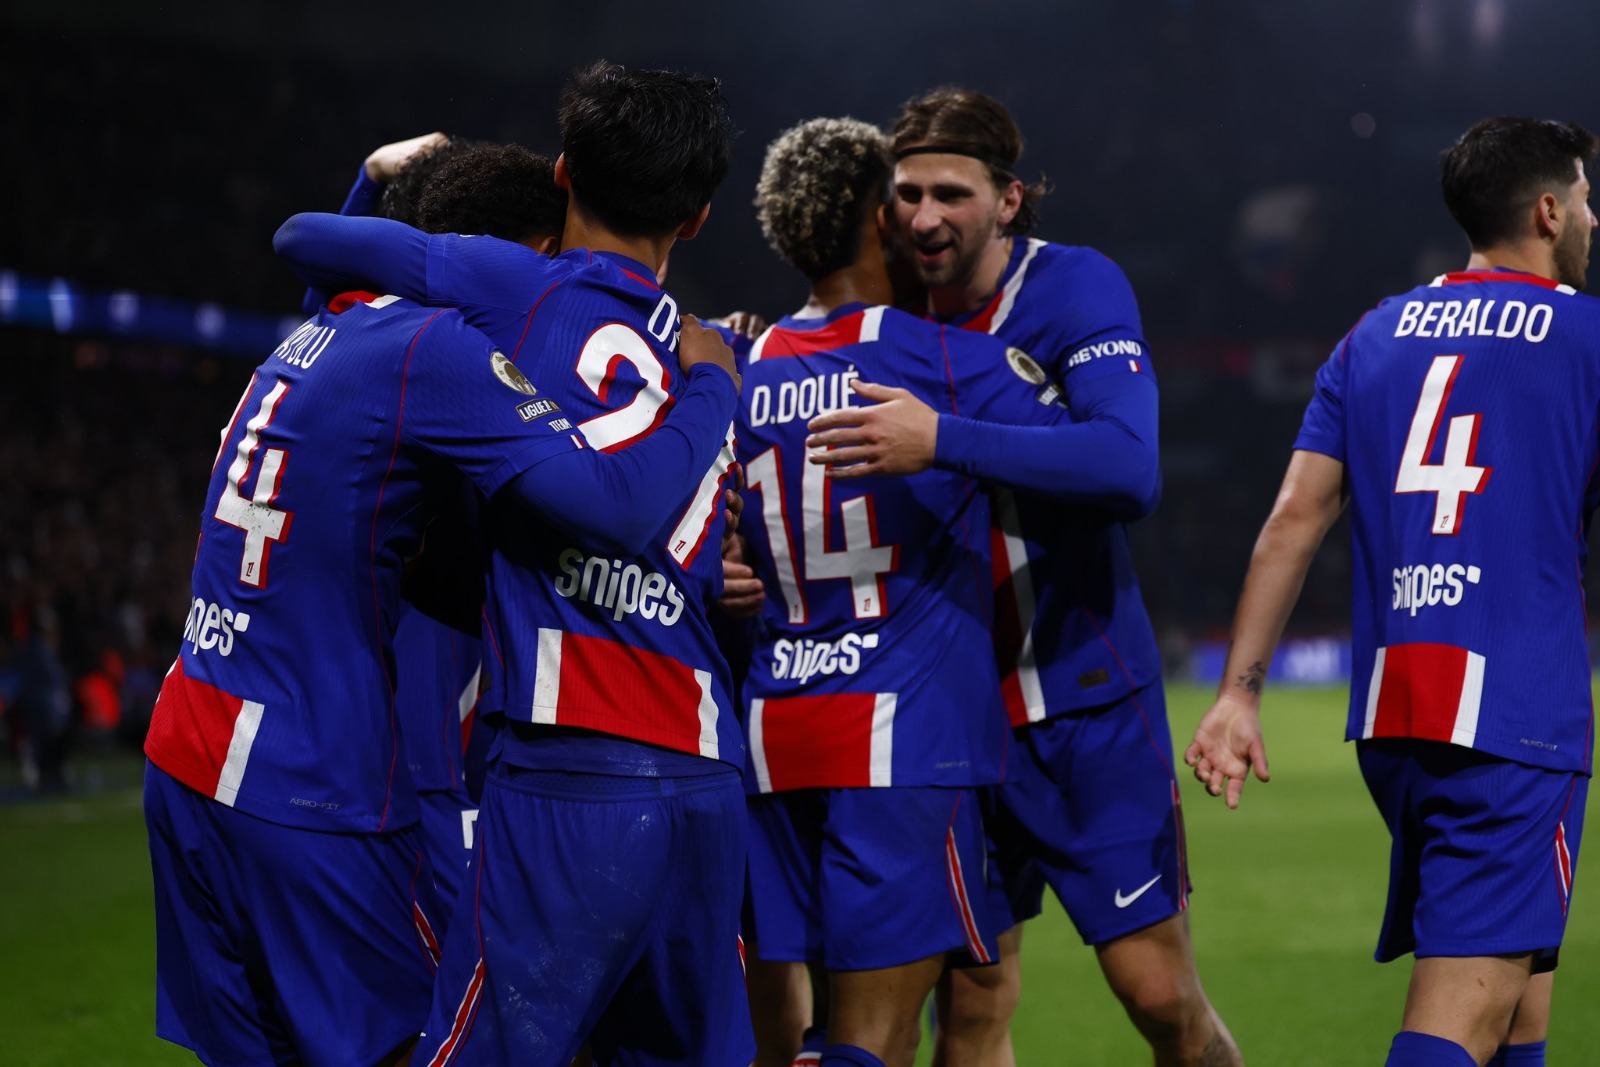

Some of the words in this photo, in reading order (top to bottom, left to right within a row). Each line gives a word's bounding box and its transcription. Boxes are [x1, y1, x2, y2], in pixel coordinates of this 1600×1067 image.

[1394, 298, 1554, 343] BERALDO
[1068, 339, 1142, 367] BEYOND
[750, 364, 860, 428] D.DOUÉ
[1394, 354, 1493, 536] 4
[194, 370, 296, 591] 4
[745, 430, 900, 625] 14
[555, 548, 685, 626] snipes
[1392, 563, 1465, 617] snipes
[771, 632, 863, 685] snipes
[289, 798, 341, 811] AERO-FIT
